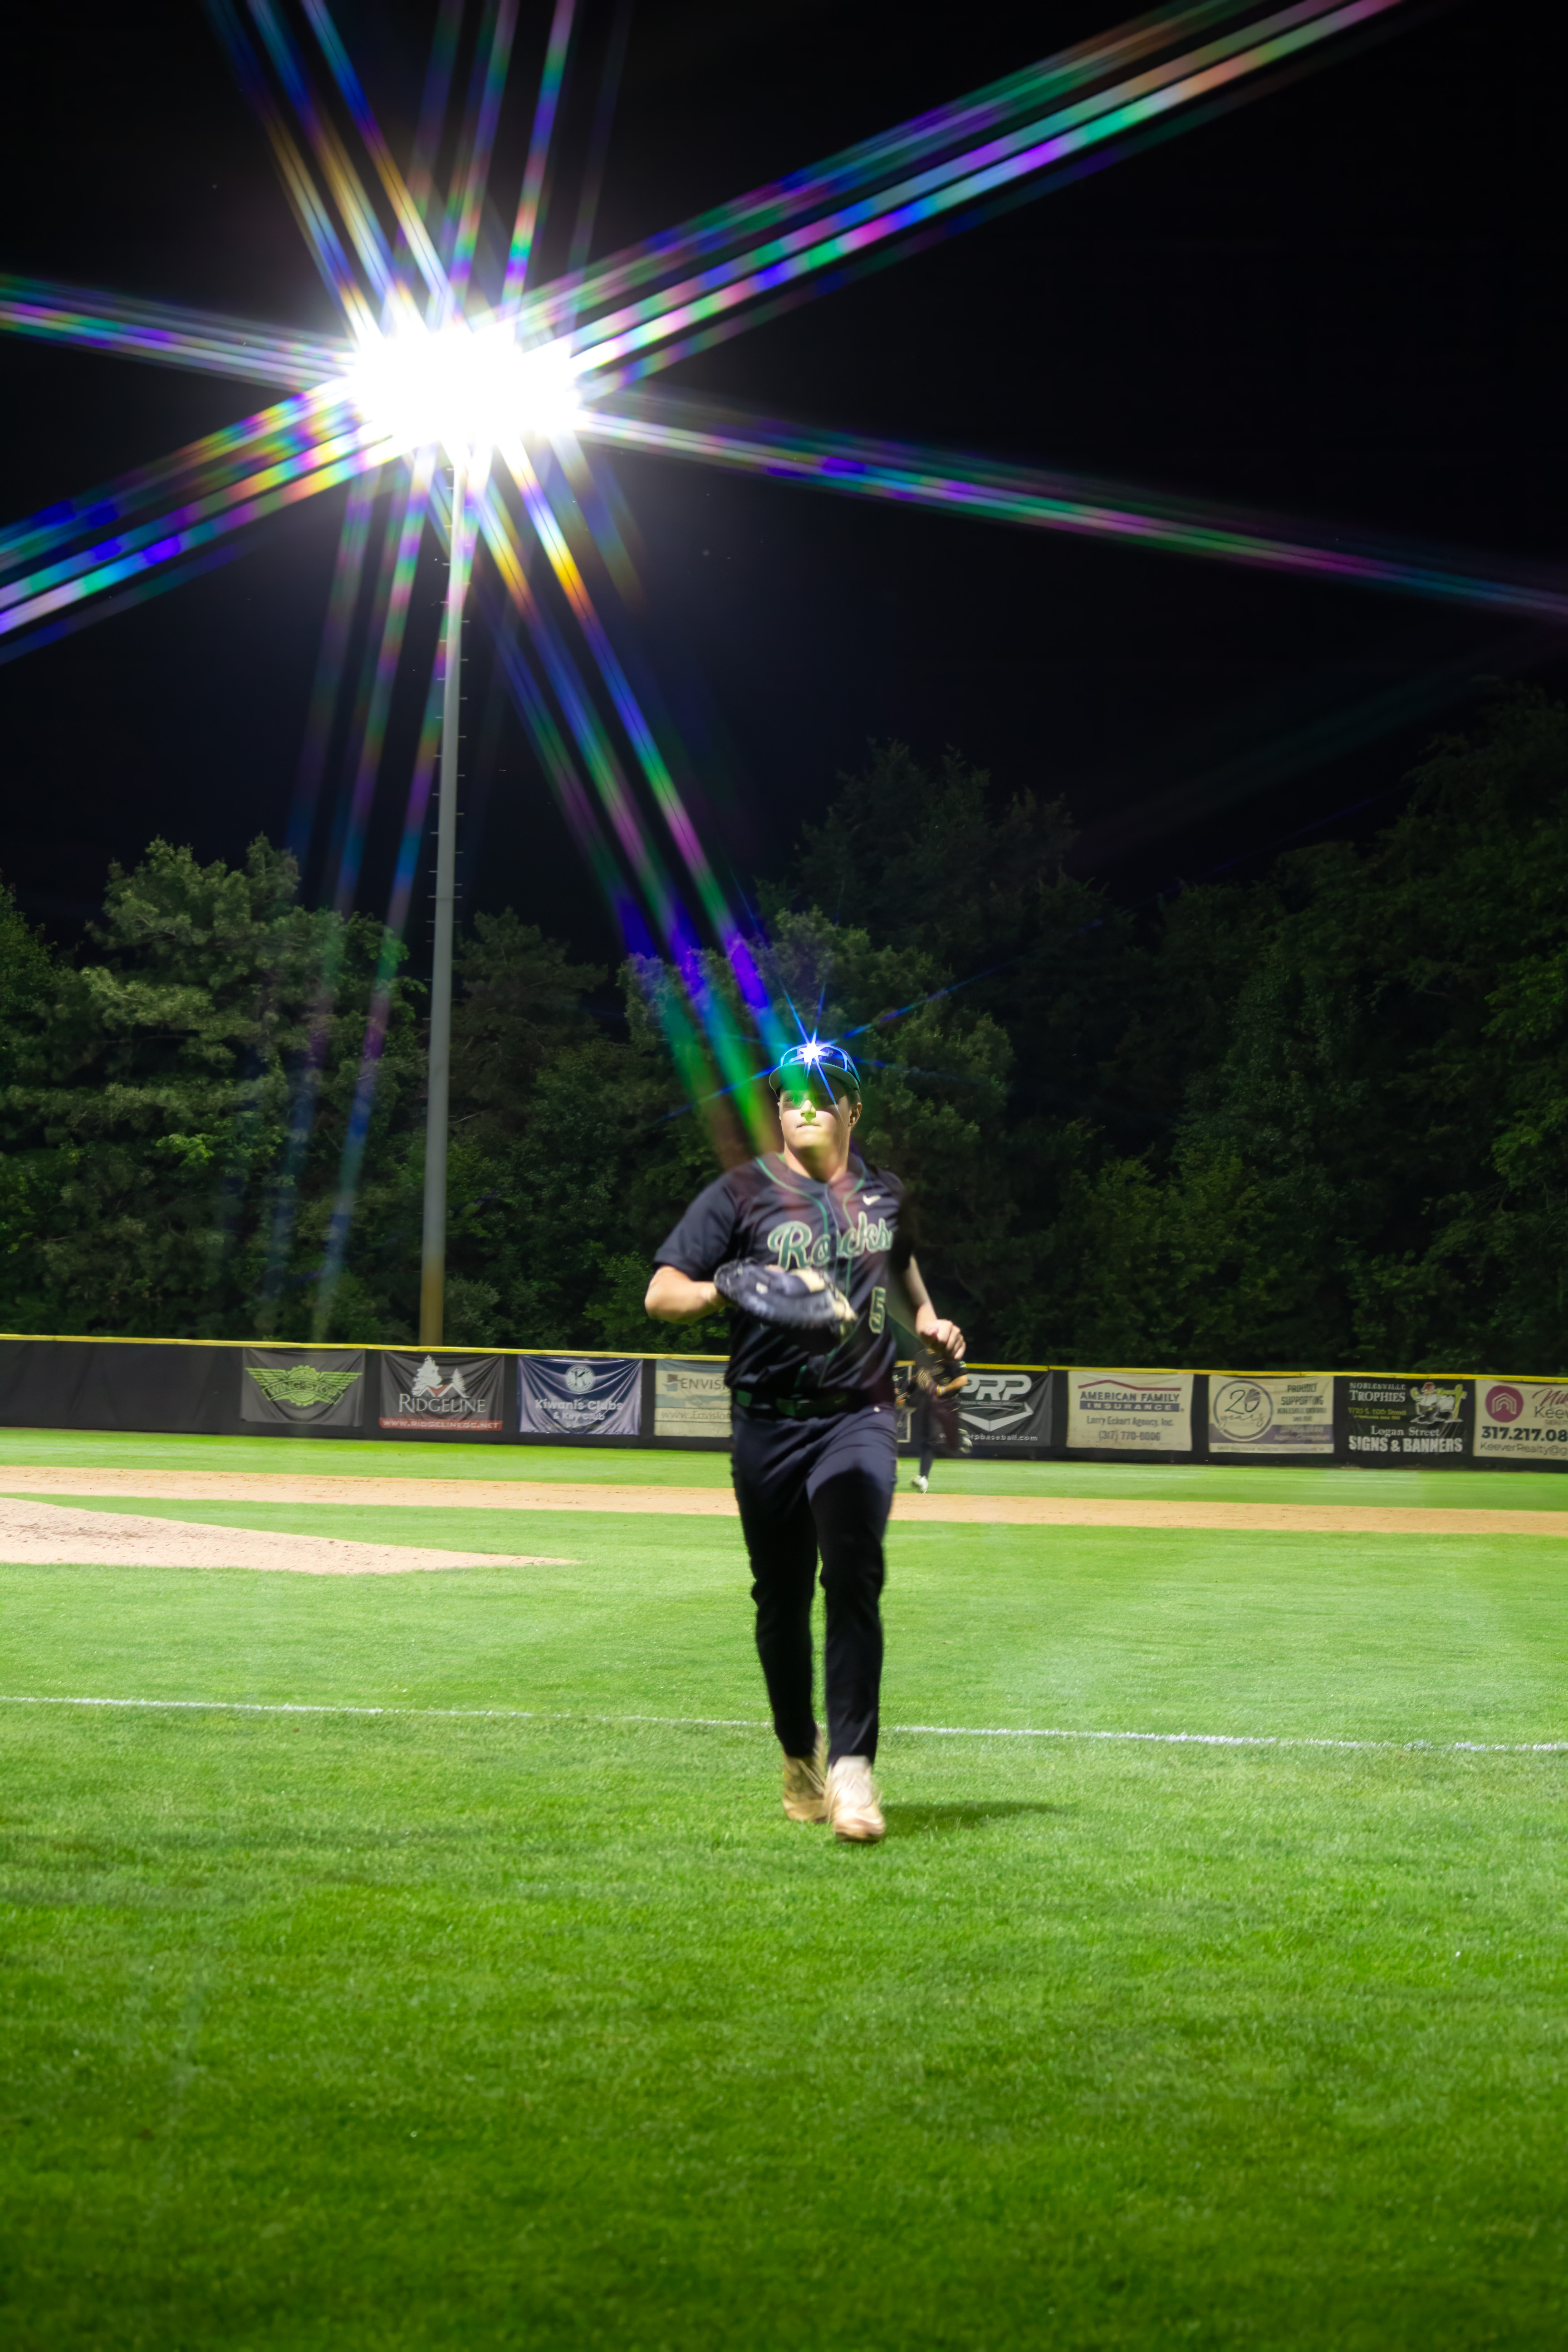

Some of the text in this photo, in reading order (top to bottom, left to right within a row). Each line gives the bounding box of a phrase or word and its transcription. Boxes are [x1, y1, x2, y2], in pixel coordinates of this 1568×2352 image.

[1080, 1391, 1180, 1402] AMERICAN FAMILY
[1224, 1388, 1261, 1414] 20
[1281, 1396, 1324, 1405] SUPPORTING
[1349, 1390, 1406, 1402] TROPHIES
[398, 1393, 486, 1413] RIDGELINE
[535, 1398, 623, 1411] Kiwanis Clubs
[1087, 1416, 1105, 1426] Larry
[1098, 1430, 1118, 1441] (317)
[1371, 1426, 1441, 1437] Logan Street
[1348, 1435, 1463, 1452] SIGNS & BANNERS
